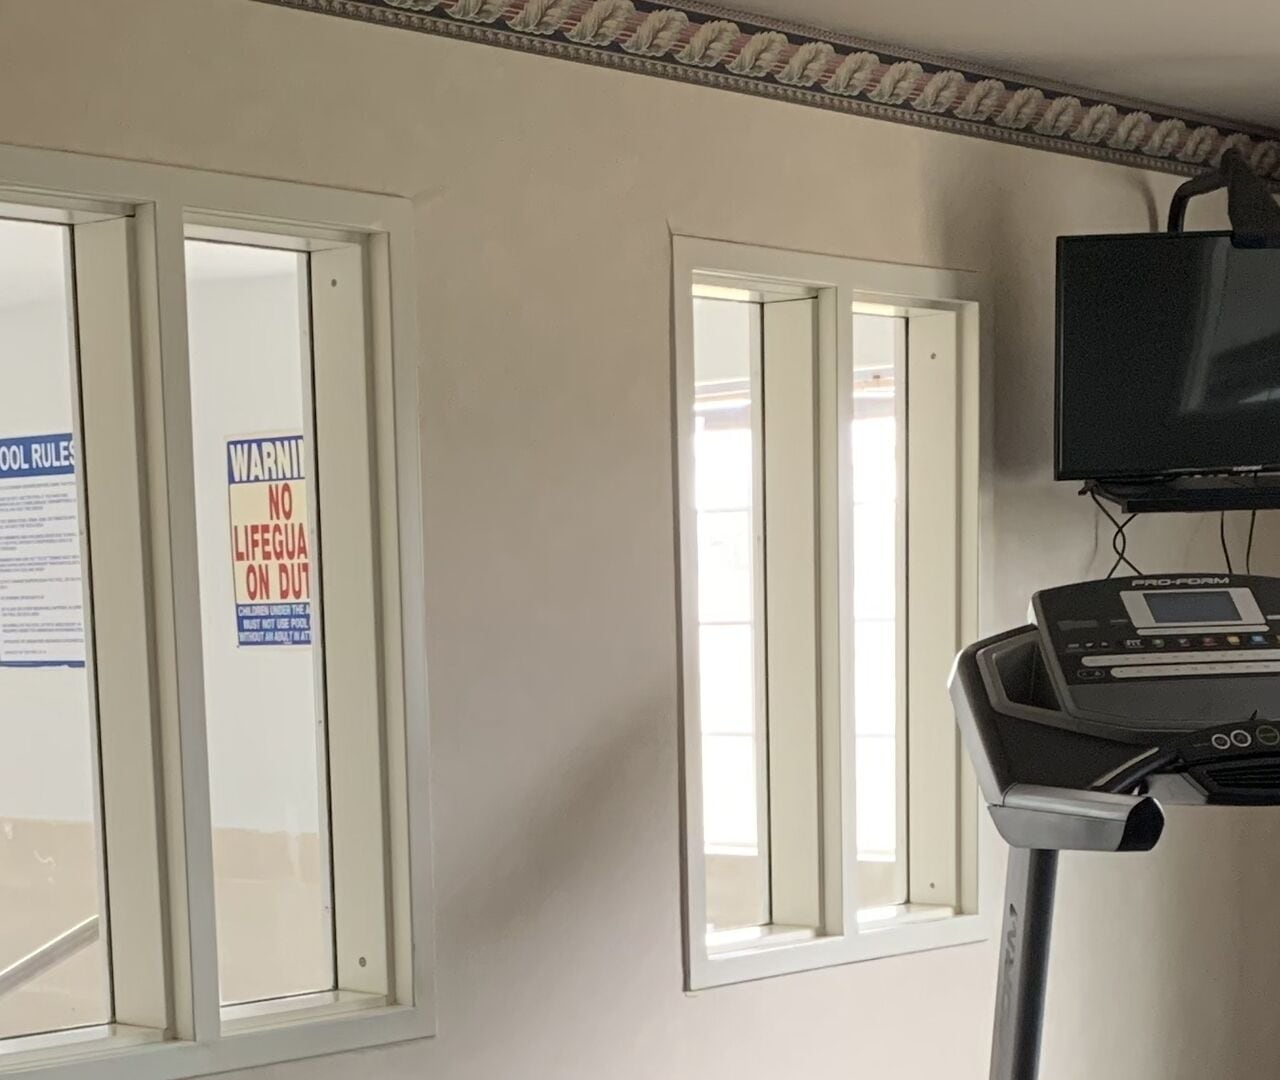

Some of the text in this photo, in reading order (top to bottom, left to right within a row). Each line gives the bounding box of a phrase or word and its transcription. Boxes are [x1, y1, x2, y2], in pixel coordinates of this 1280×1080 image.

[269, 482, 293, 520] NO
[234, 522, 308, 562] LIFEGUA
[246, 564, 270, 600] ON
[1132, 577, 1230, 587] PRO-FORM
[276, 618, 289, 629] USE
[290, 617, 308, 629] POOL
